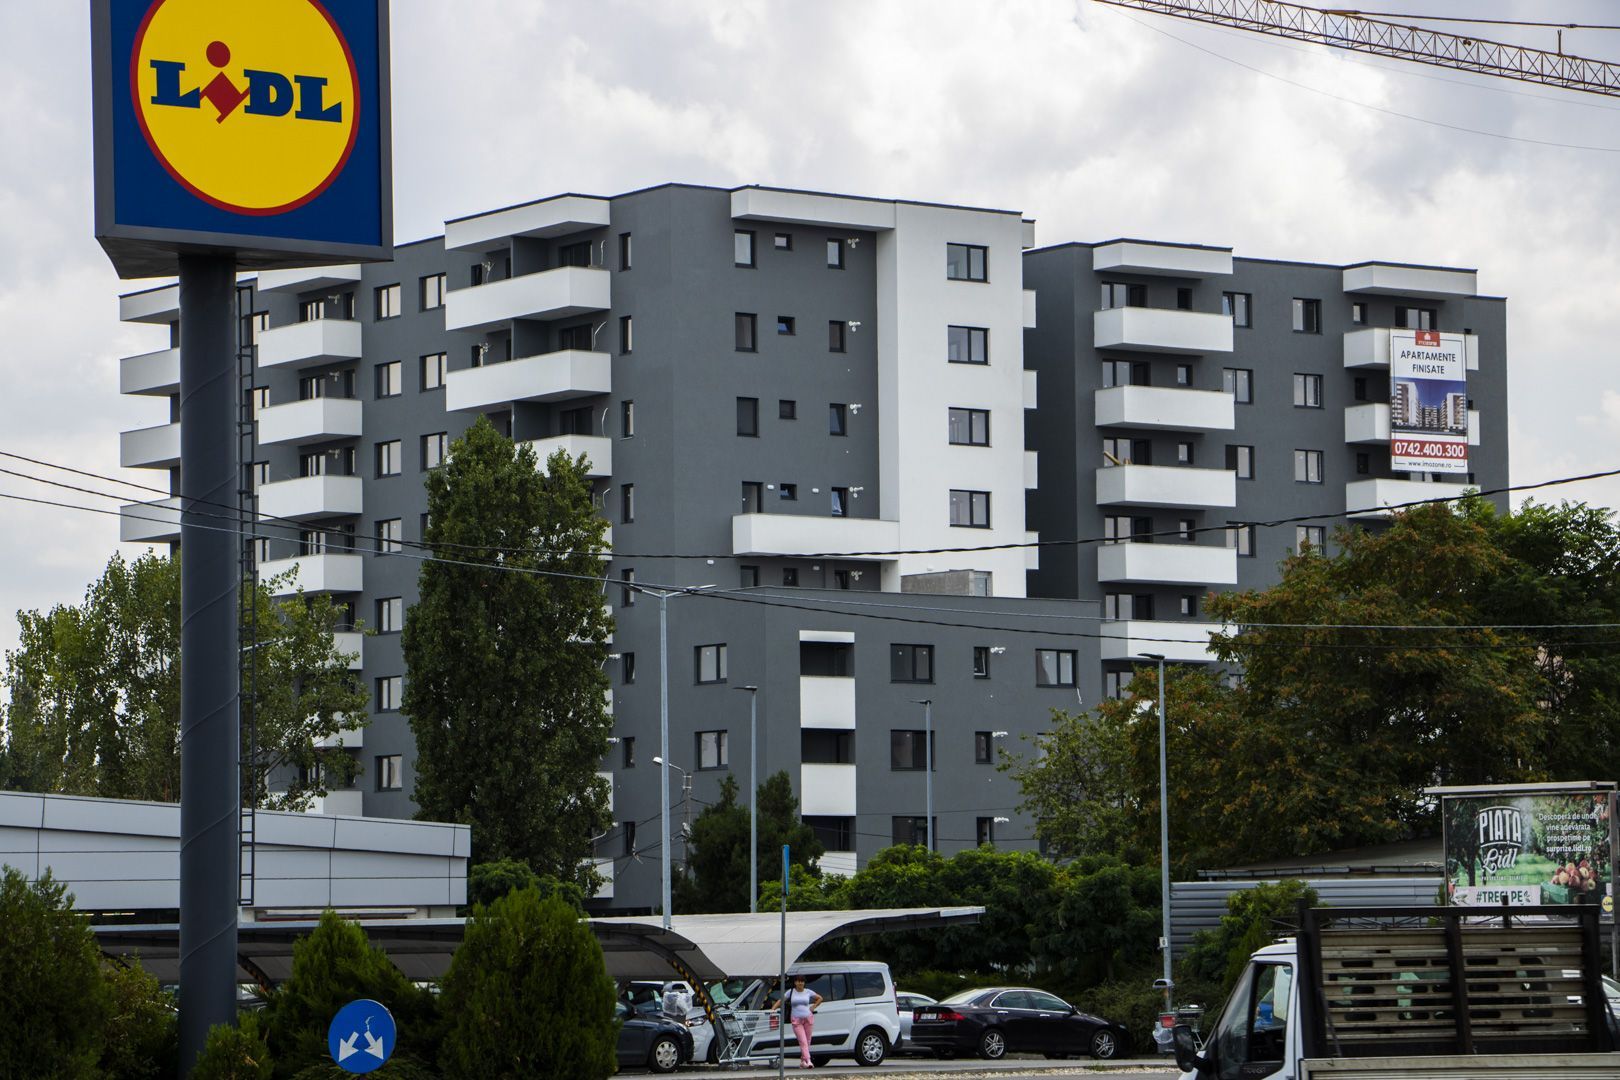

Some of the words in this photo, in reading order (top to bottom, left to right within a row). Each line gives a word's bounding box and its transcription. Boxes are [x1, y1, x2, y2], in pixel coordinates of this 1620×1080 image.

[1400, 350, 1456, 362] APARTAMENTE
[1412, 364, 1445, 374] FINISATE
[1394, 441, 1465, 457] 0742.400.300
[1546, 823, 1560, 831] vine
[1482, 848, 1518, 874] Lidl
[1511, 890, 1523, 903] PE
